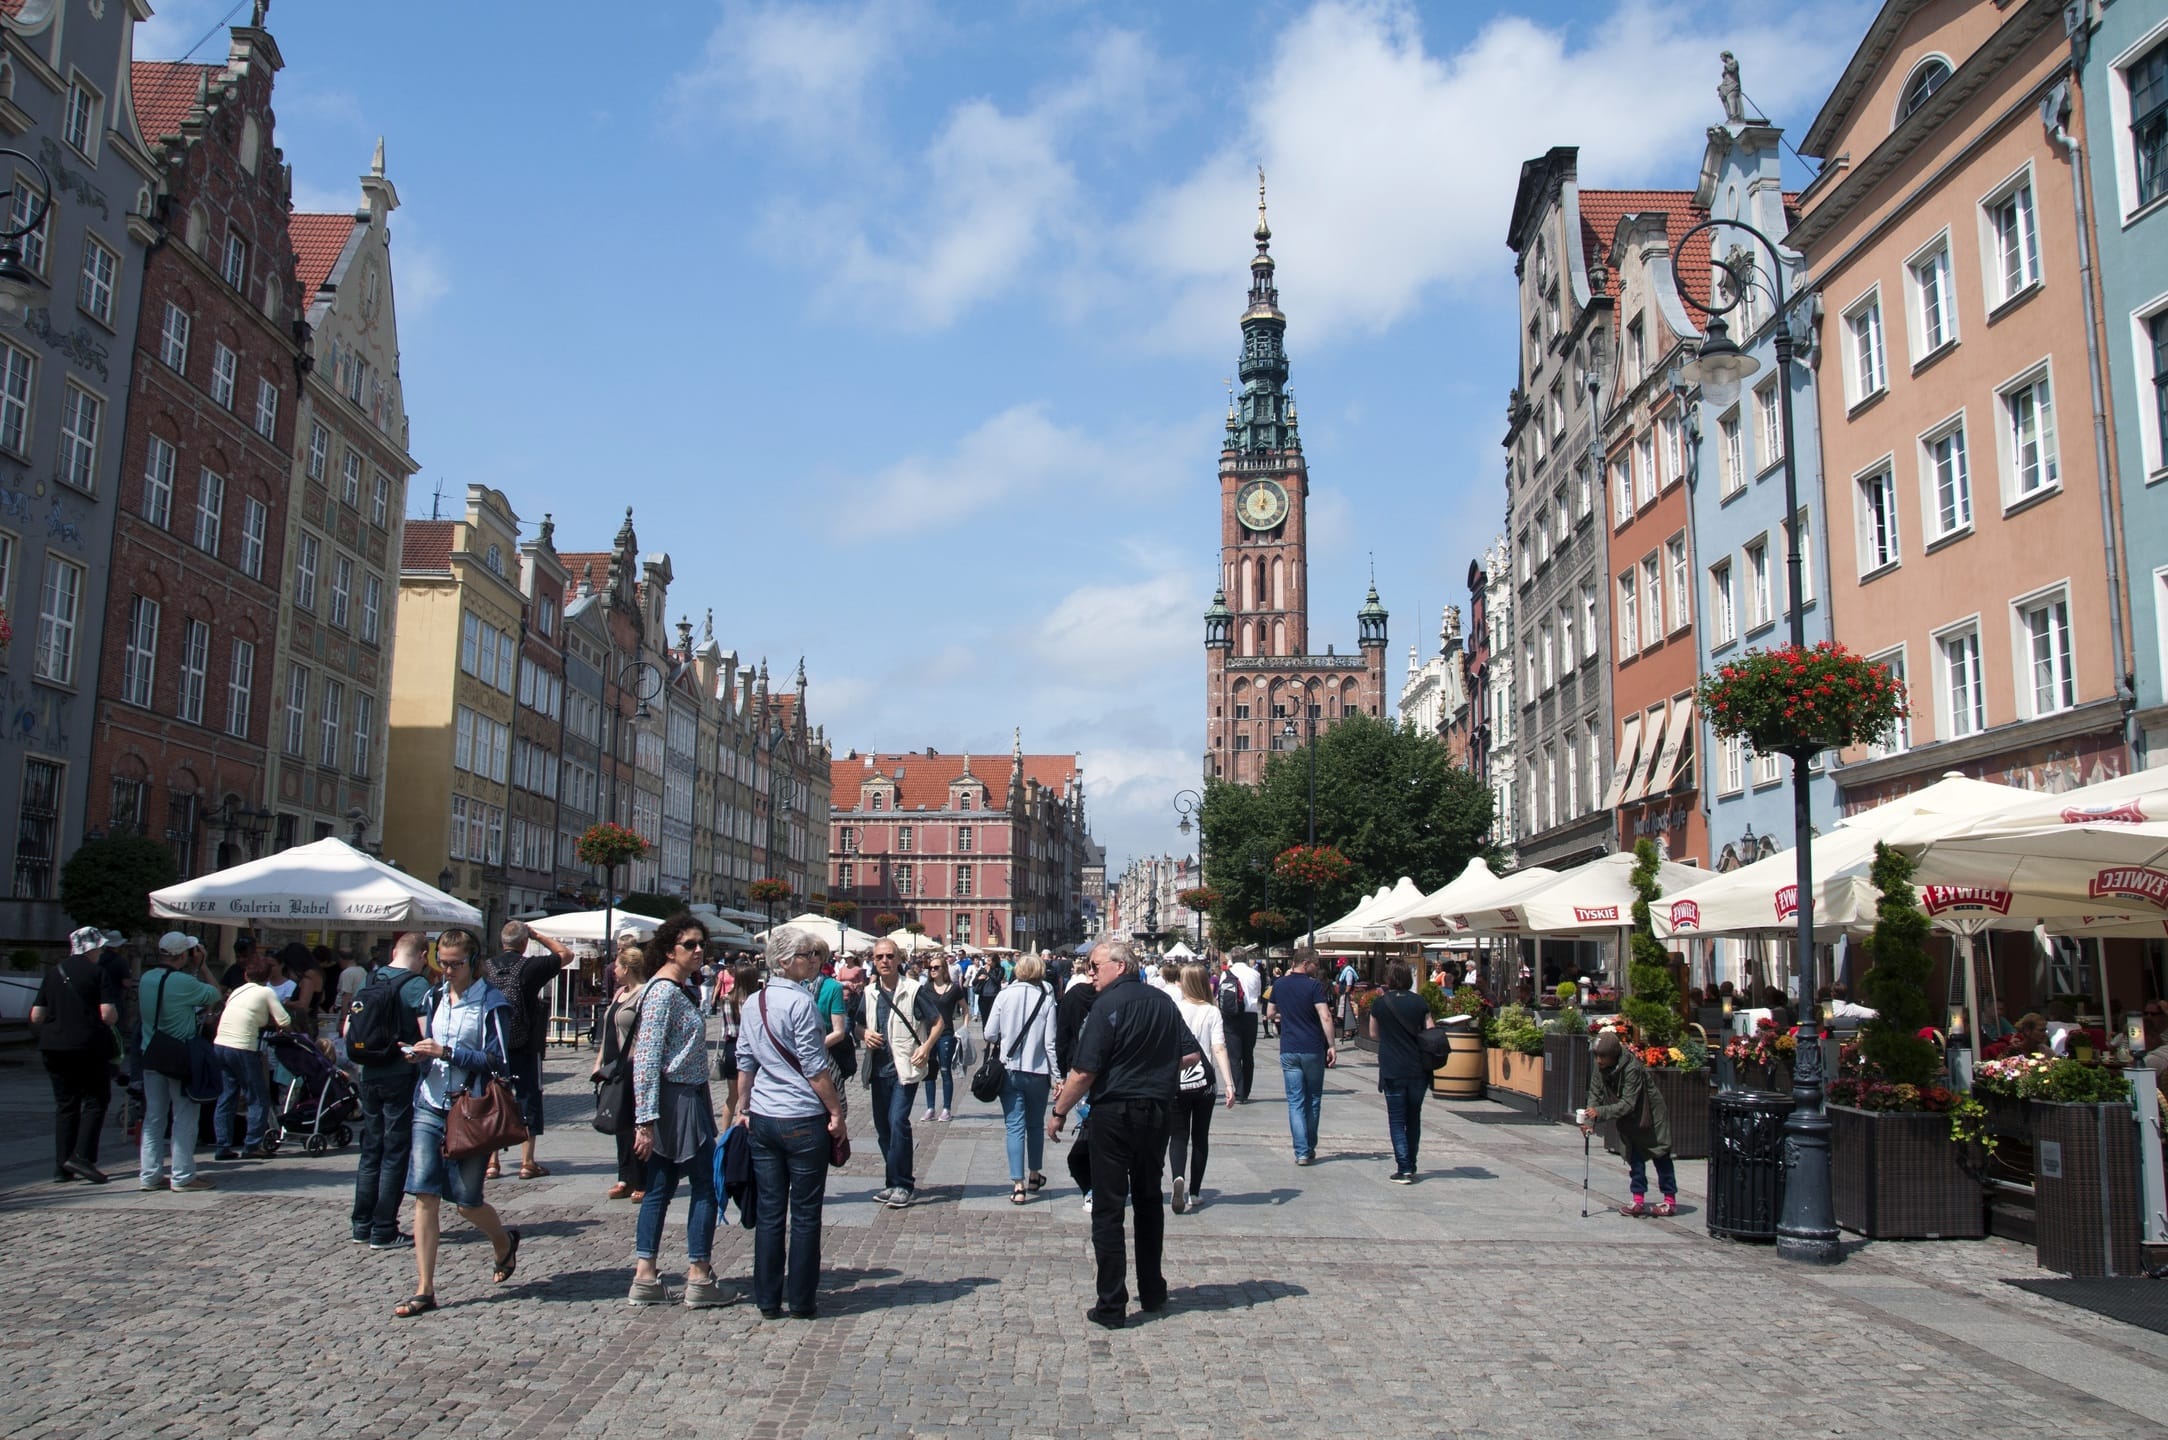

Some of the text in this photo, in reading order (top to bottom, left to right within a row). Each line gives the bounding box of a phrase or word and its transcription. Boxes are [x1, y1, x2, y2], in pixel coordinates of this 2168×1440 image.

[169, 901, 217, 913] SILVER
[230, 898, 281, 914] Galeria
[343, 904, 392, 915] AMBER
[1577, 908, 1617, 920] TYSKIE
